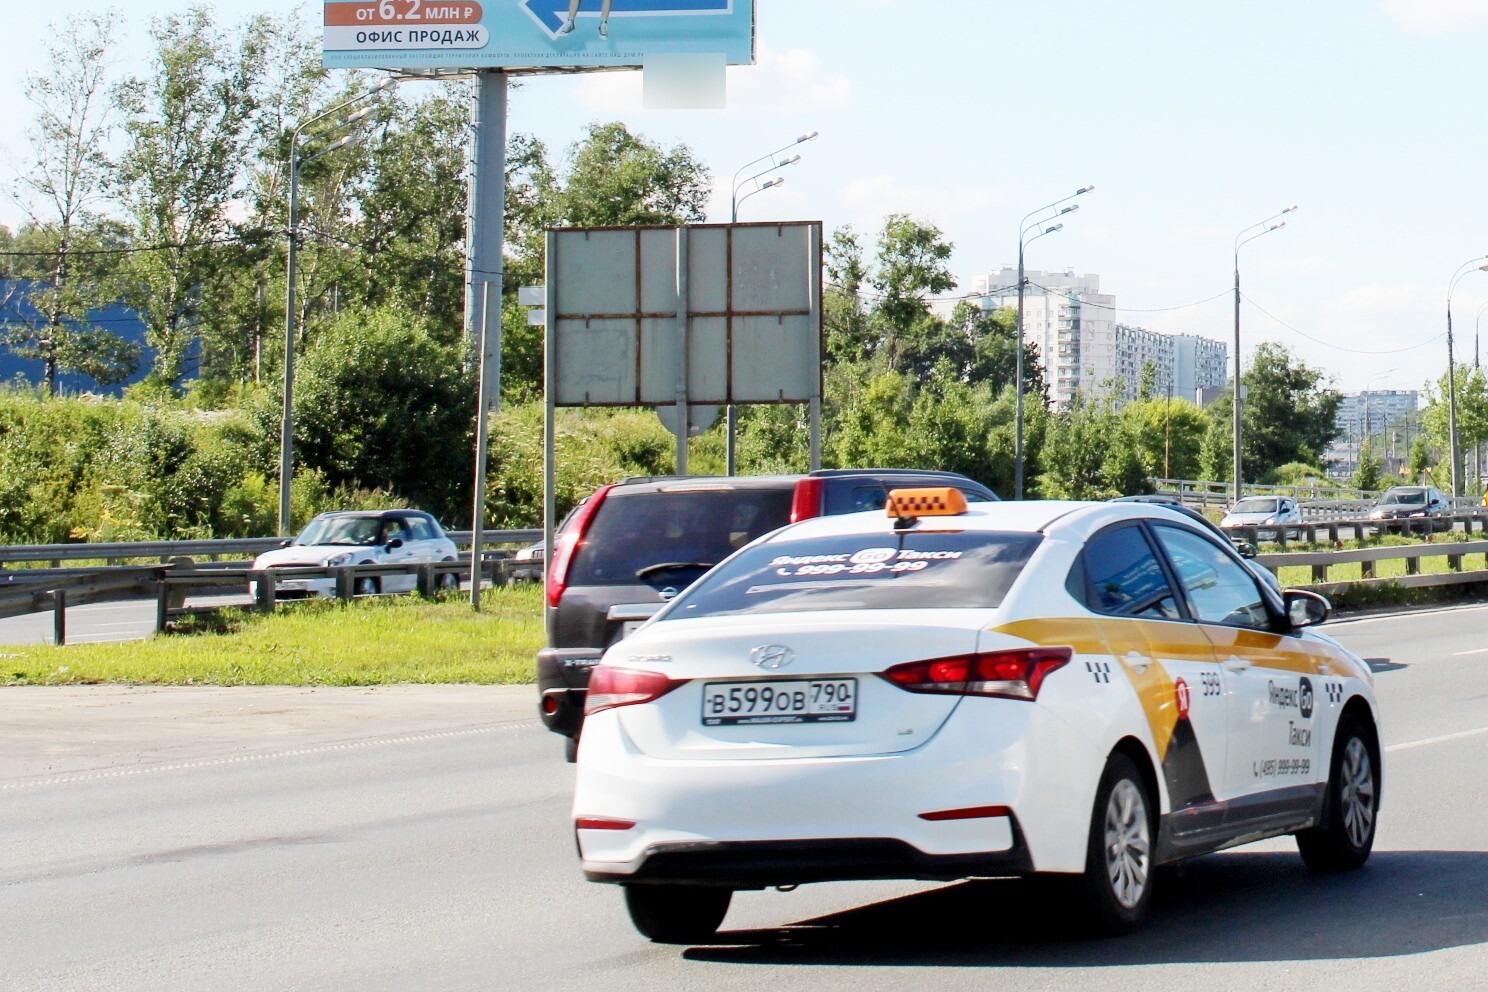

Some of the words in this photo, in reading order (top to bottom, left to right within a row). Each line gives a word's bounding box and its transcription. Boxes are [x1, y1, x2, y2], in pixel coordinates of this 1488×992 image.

[425, 7, 459, 19] МЛН
[356, 31, 403, 43] ОФИС
[409, 30, 480, 44] ПРОДАЖ
[896, 549, 963, 560] Такси
[795, 560, 929, 576] 999-99-99
[811, 683, 849, 703] 790
[1288, 720, 1312, 747] Такси
